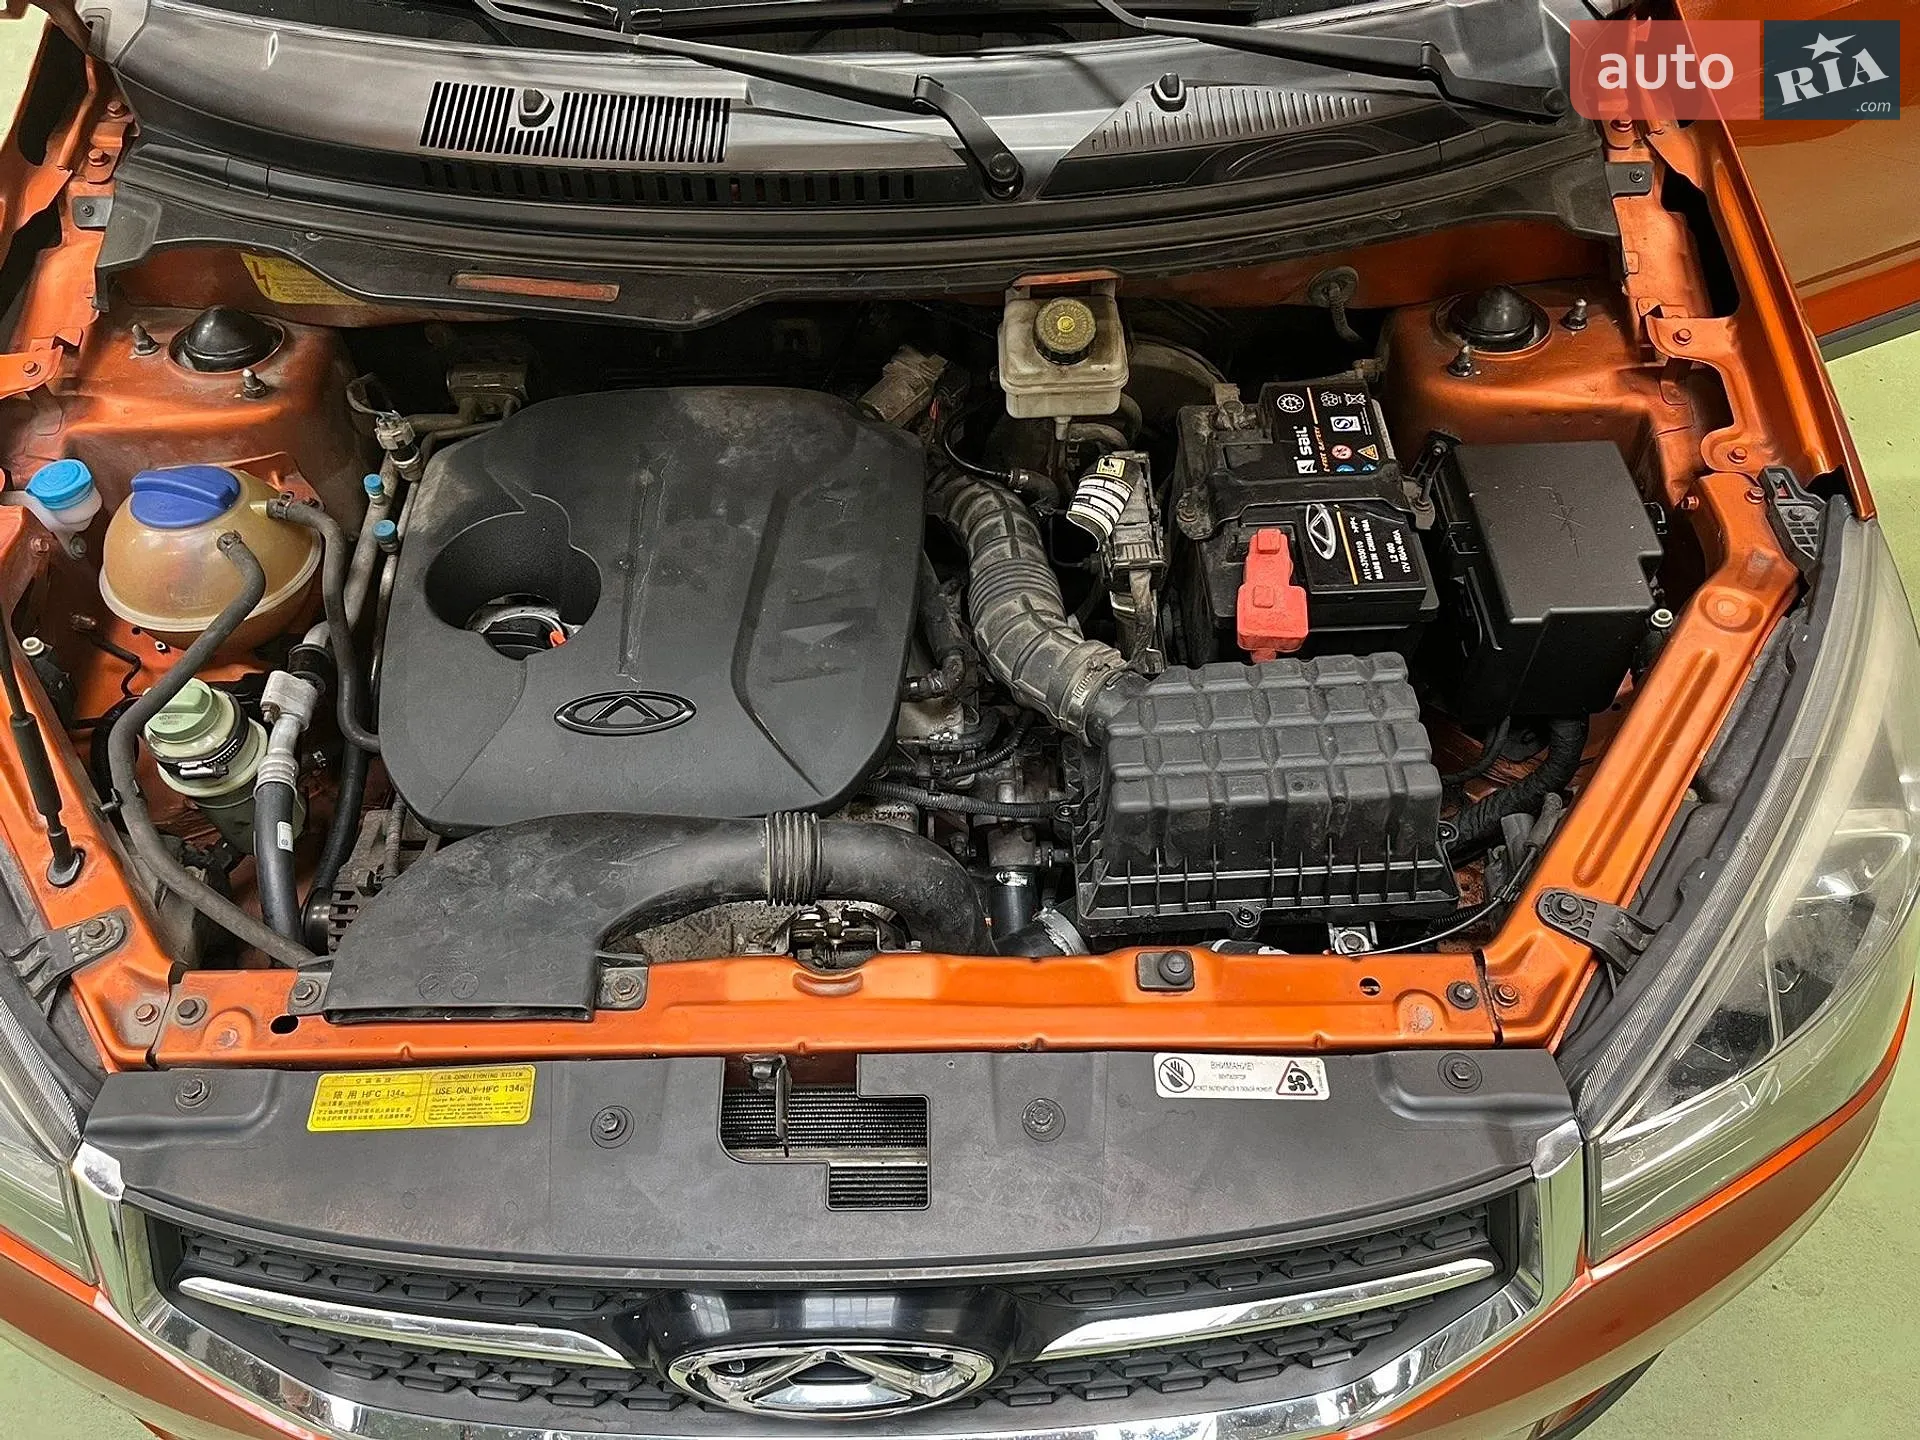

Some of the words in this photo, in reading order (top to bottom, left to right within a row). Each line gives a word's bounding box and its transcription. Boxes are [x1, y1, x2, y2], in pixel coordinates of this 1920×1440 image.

[1364, 532, 1377, 552] CHINA
[1370, 553, 1379, 561] IN
[1372, 561, 1384, 580] MADE
[1400, 561, 1411, 573] 12V
[362, 1090, 382, 1098] HFC
[435, 1087, 451, 1095] USE
[456, 1086, 477, 1094] ONLY
[505, 1084, 525, 1092] 134a
